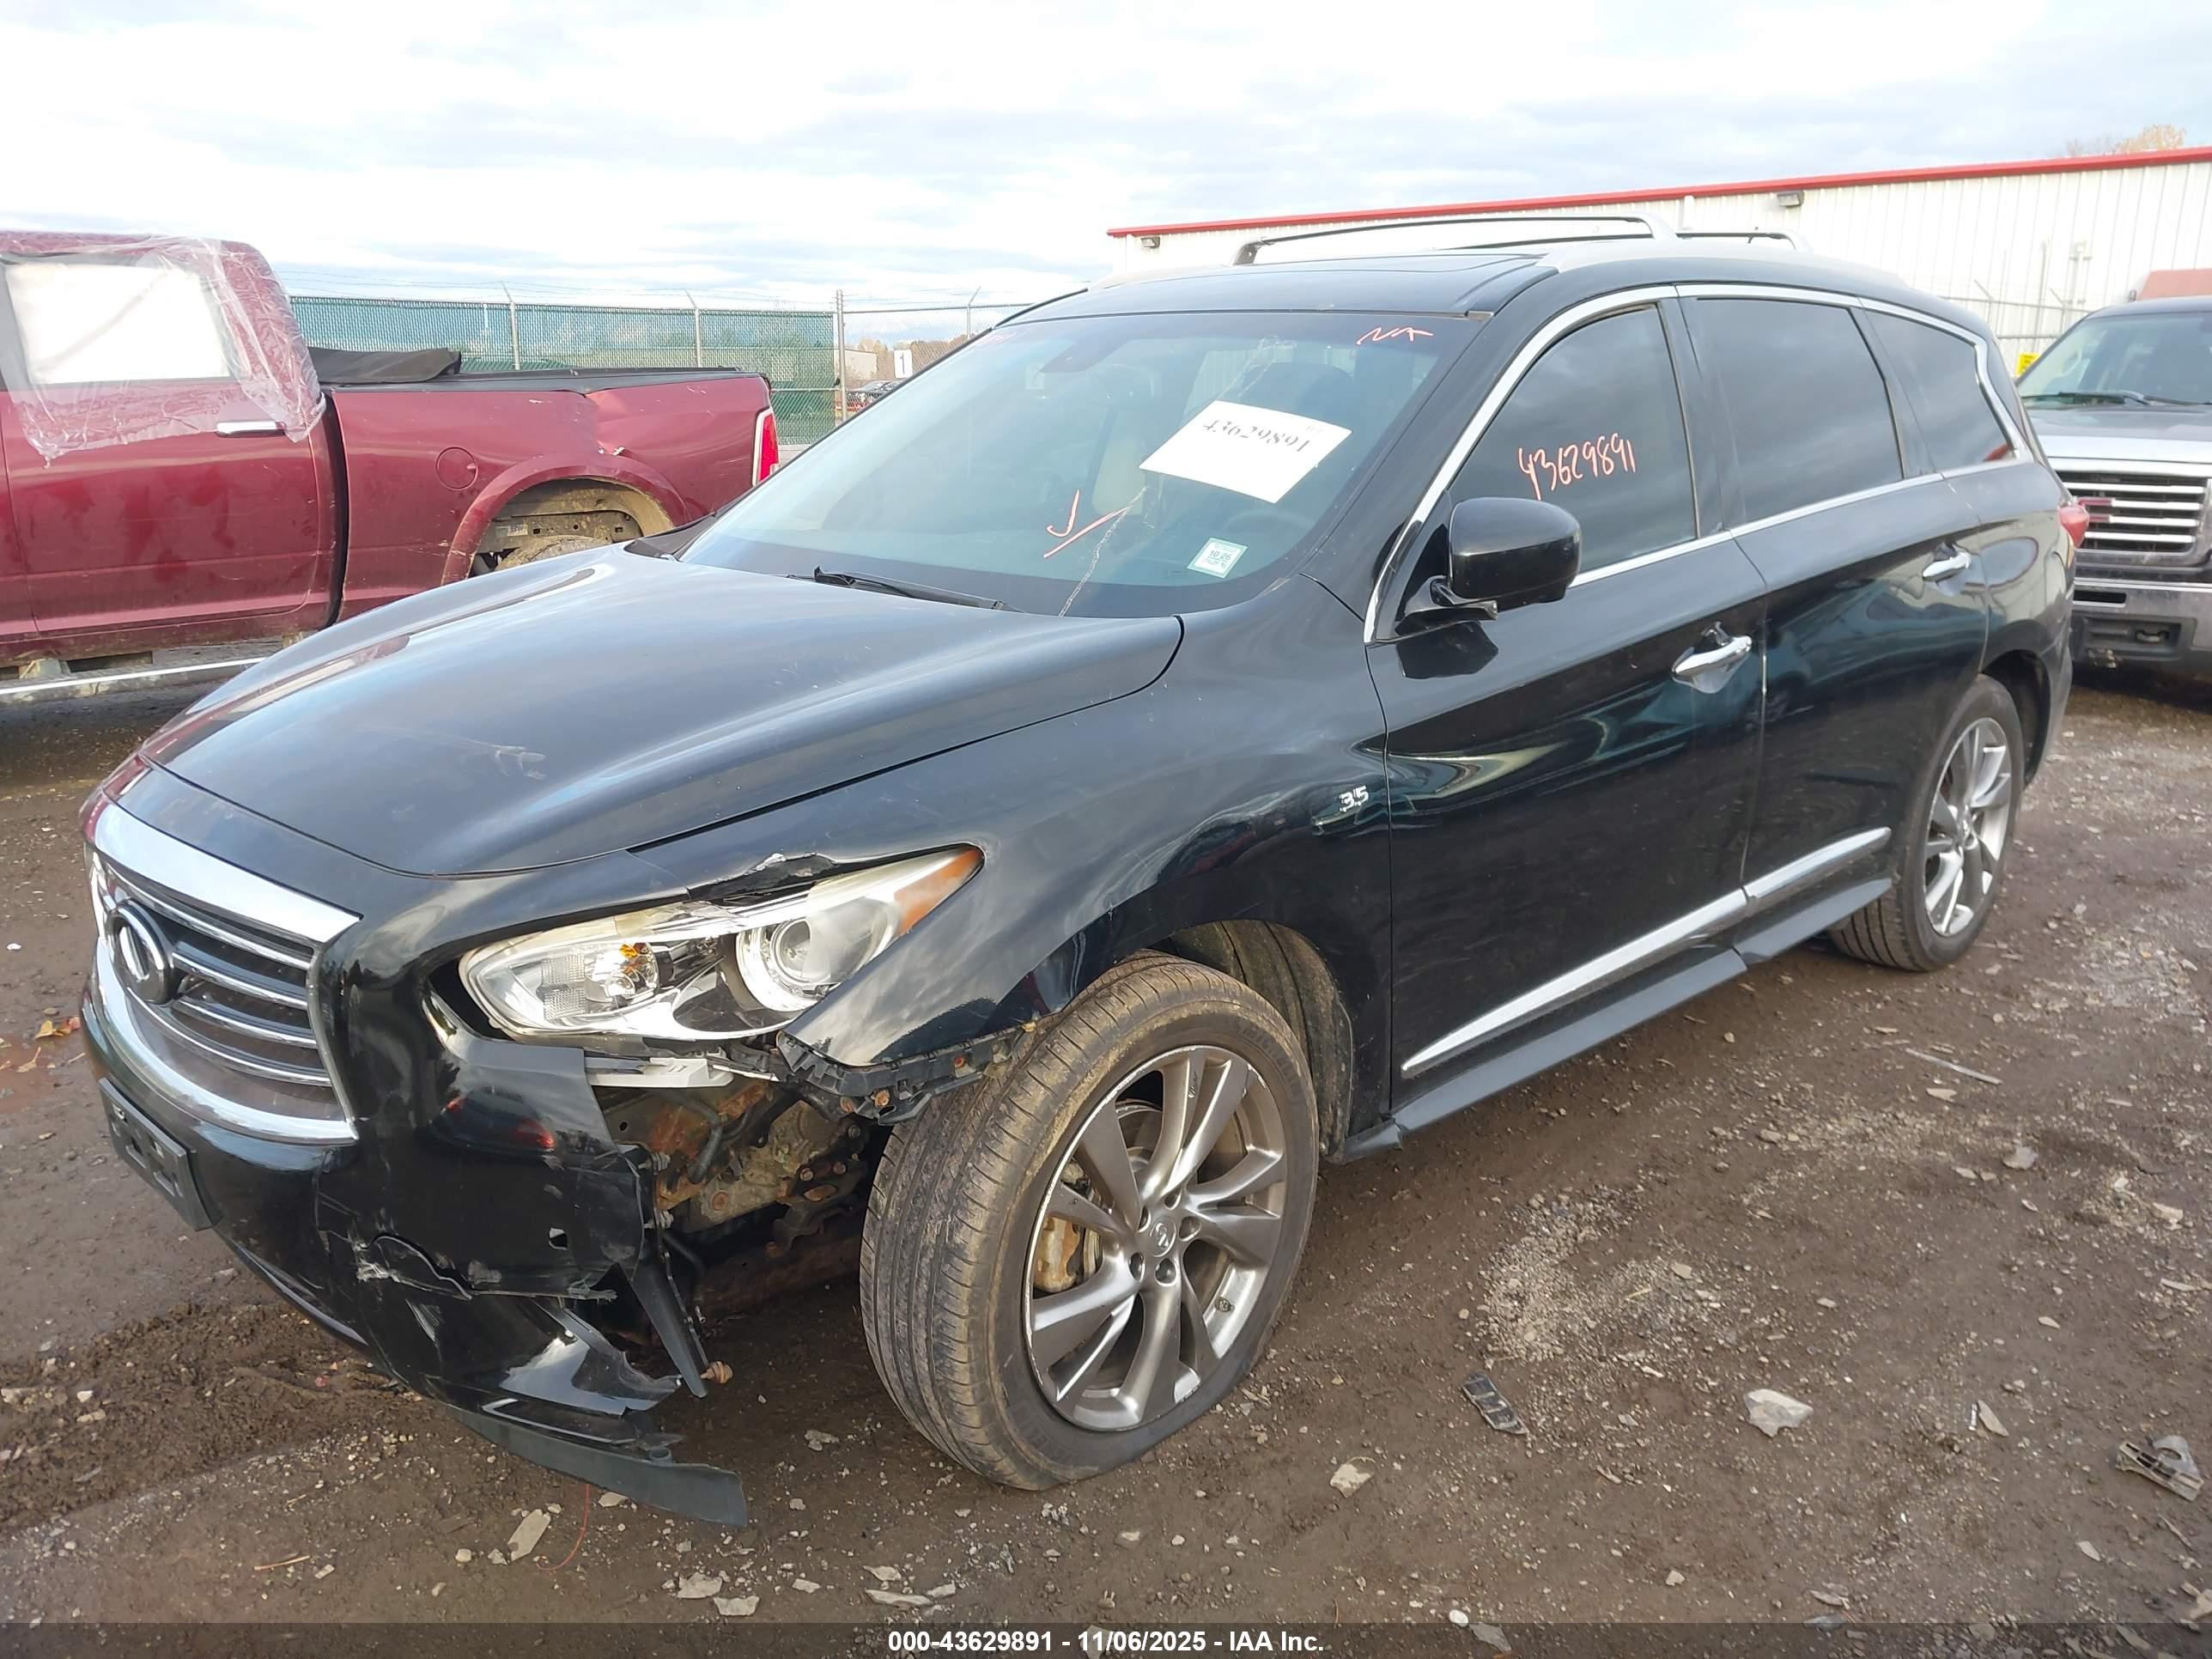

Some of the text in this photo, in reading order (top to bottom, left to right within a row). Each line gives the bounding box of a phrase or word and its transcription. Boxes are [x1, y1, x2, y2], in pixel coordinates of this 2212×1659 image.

[899, 353, 905, 375] 1
[1203, 419, 1310, 452] 43629891
[1517, 432, 1637, 501] 43629891
